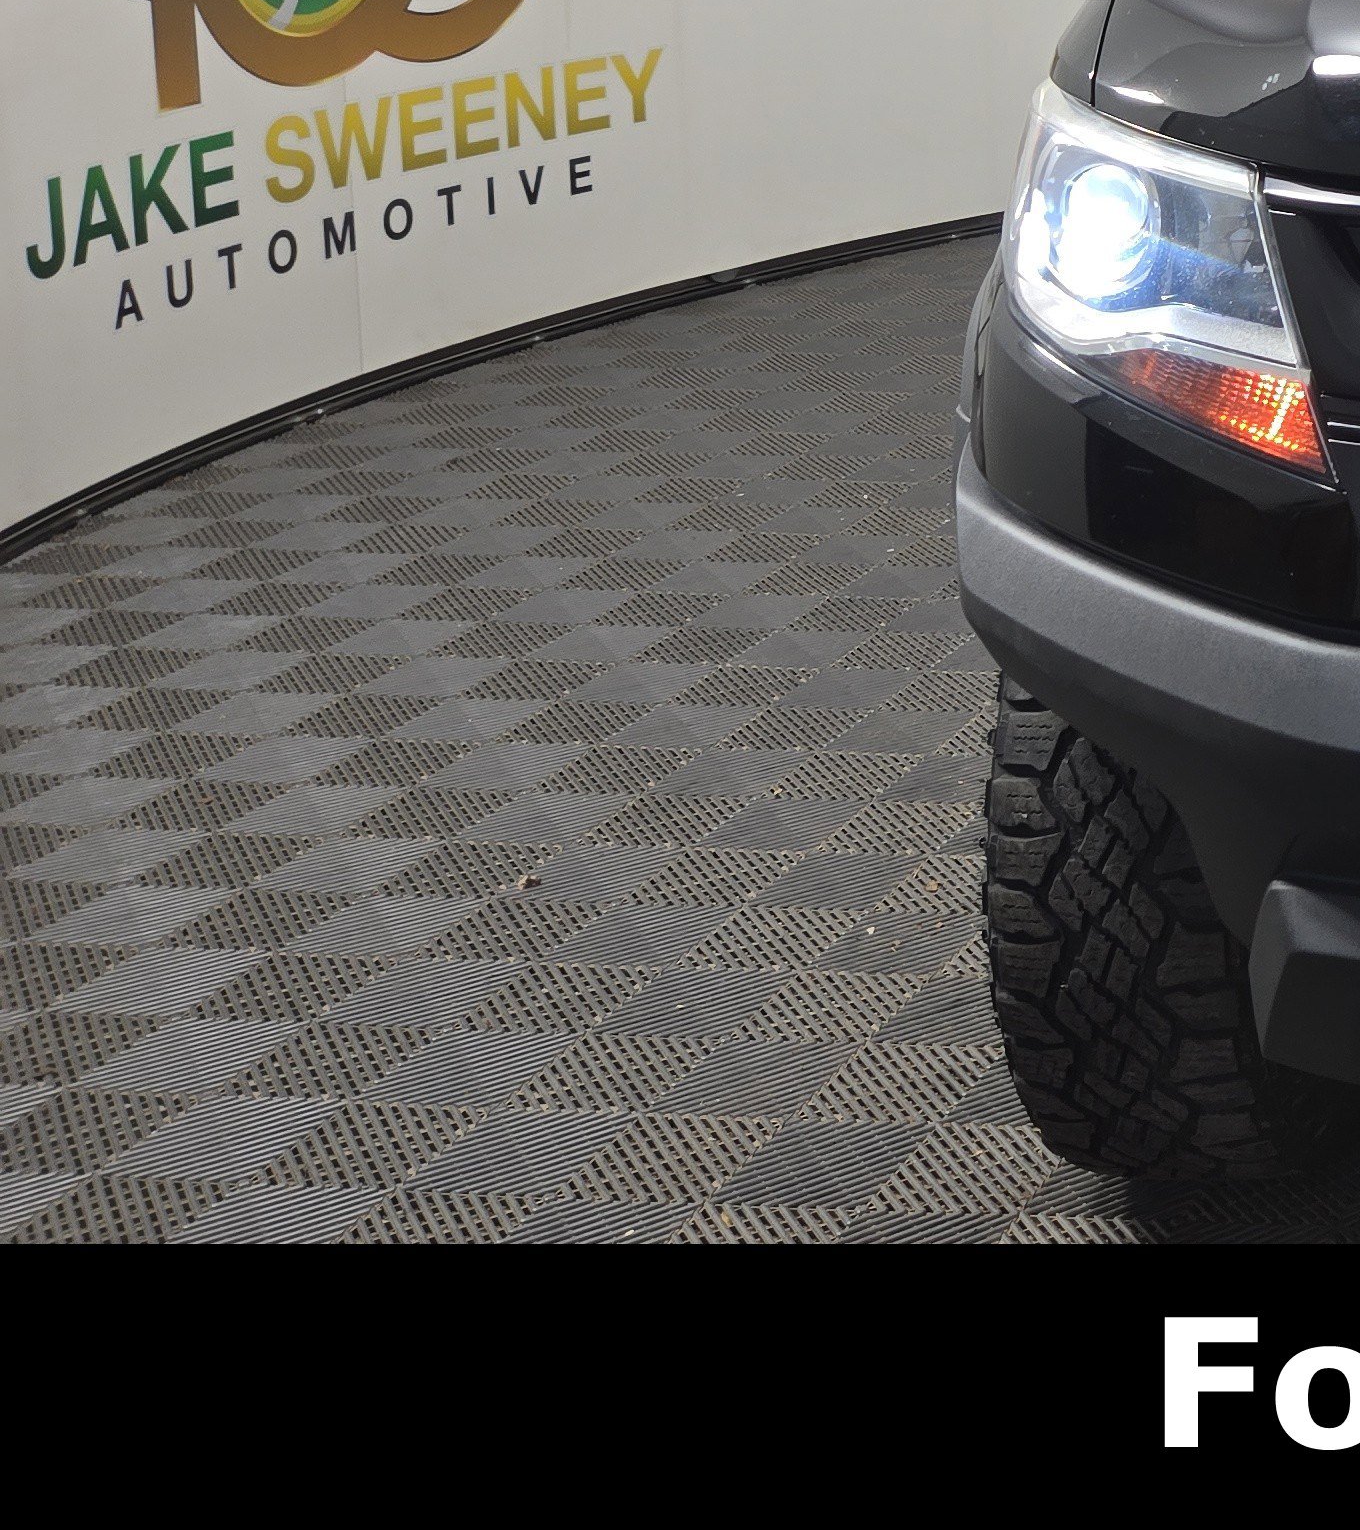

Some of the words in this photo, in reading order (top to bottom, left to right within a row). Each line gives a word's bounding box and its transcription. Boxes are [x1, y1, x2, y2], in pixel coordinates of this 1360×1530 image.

[25, 129, 241, 280] JAKE
[263, 47, 664, 205] SWEENEY
[113, 155, 594, 331] AUTOMOTIVE
